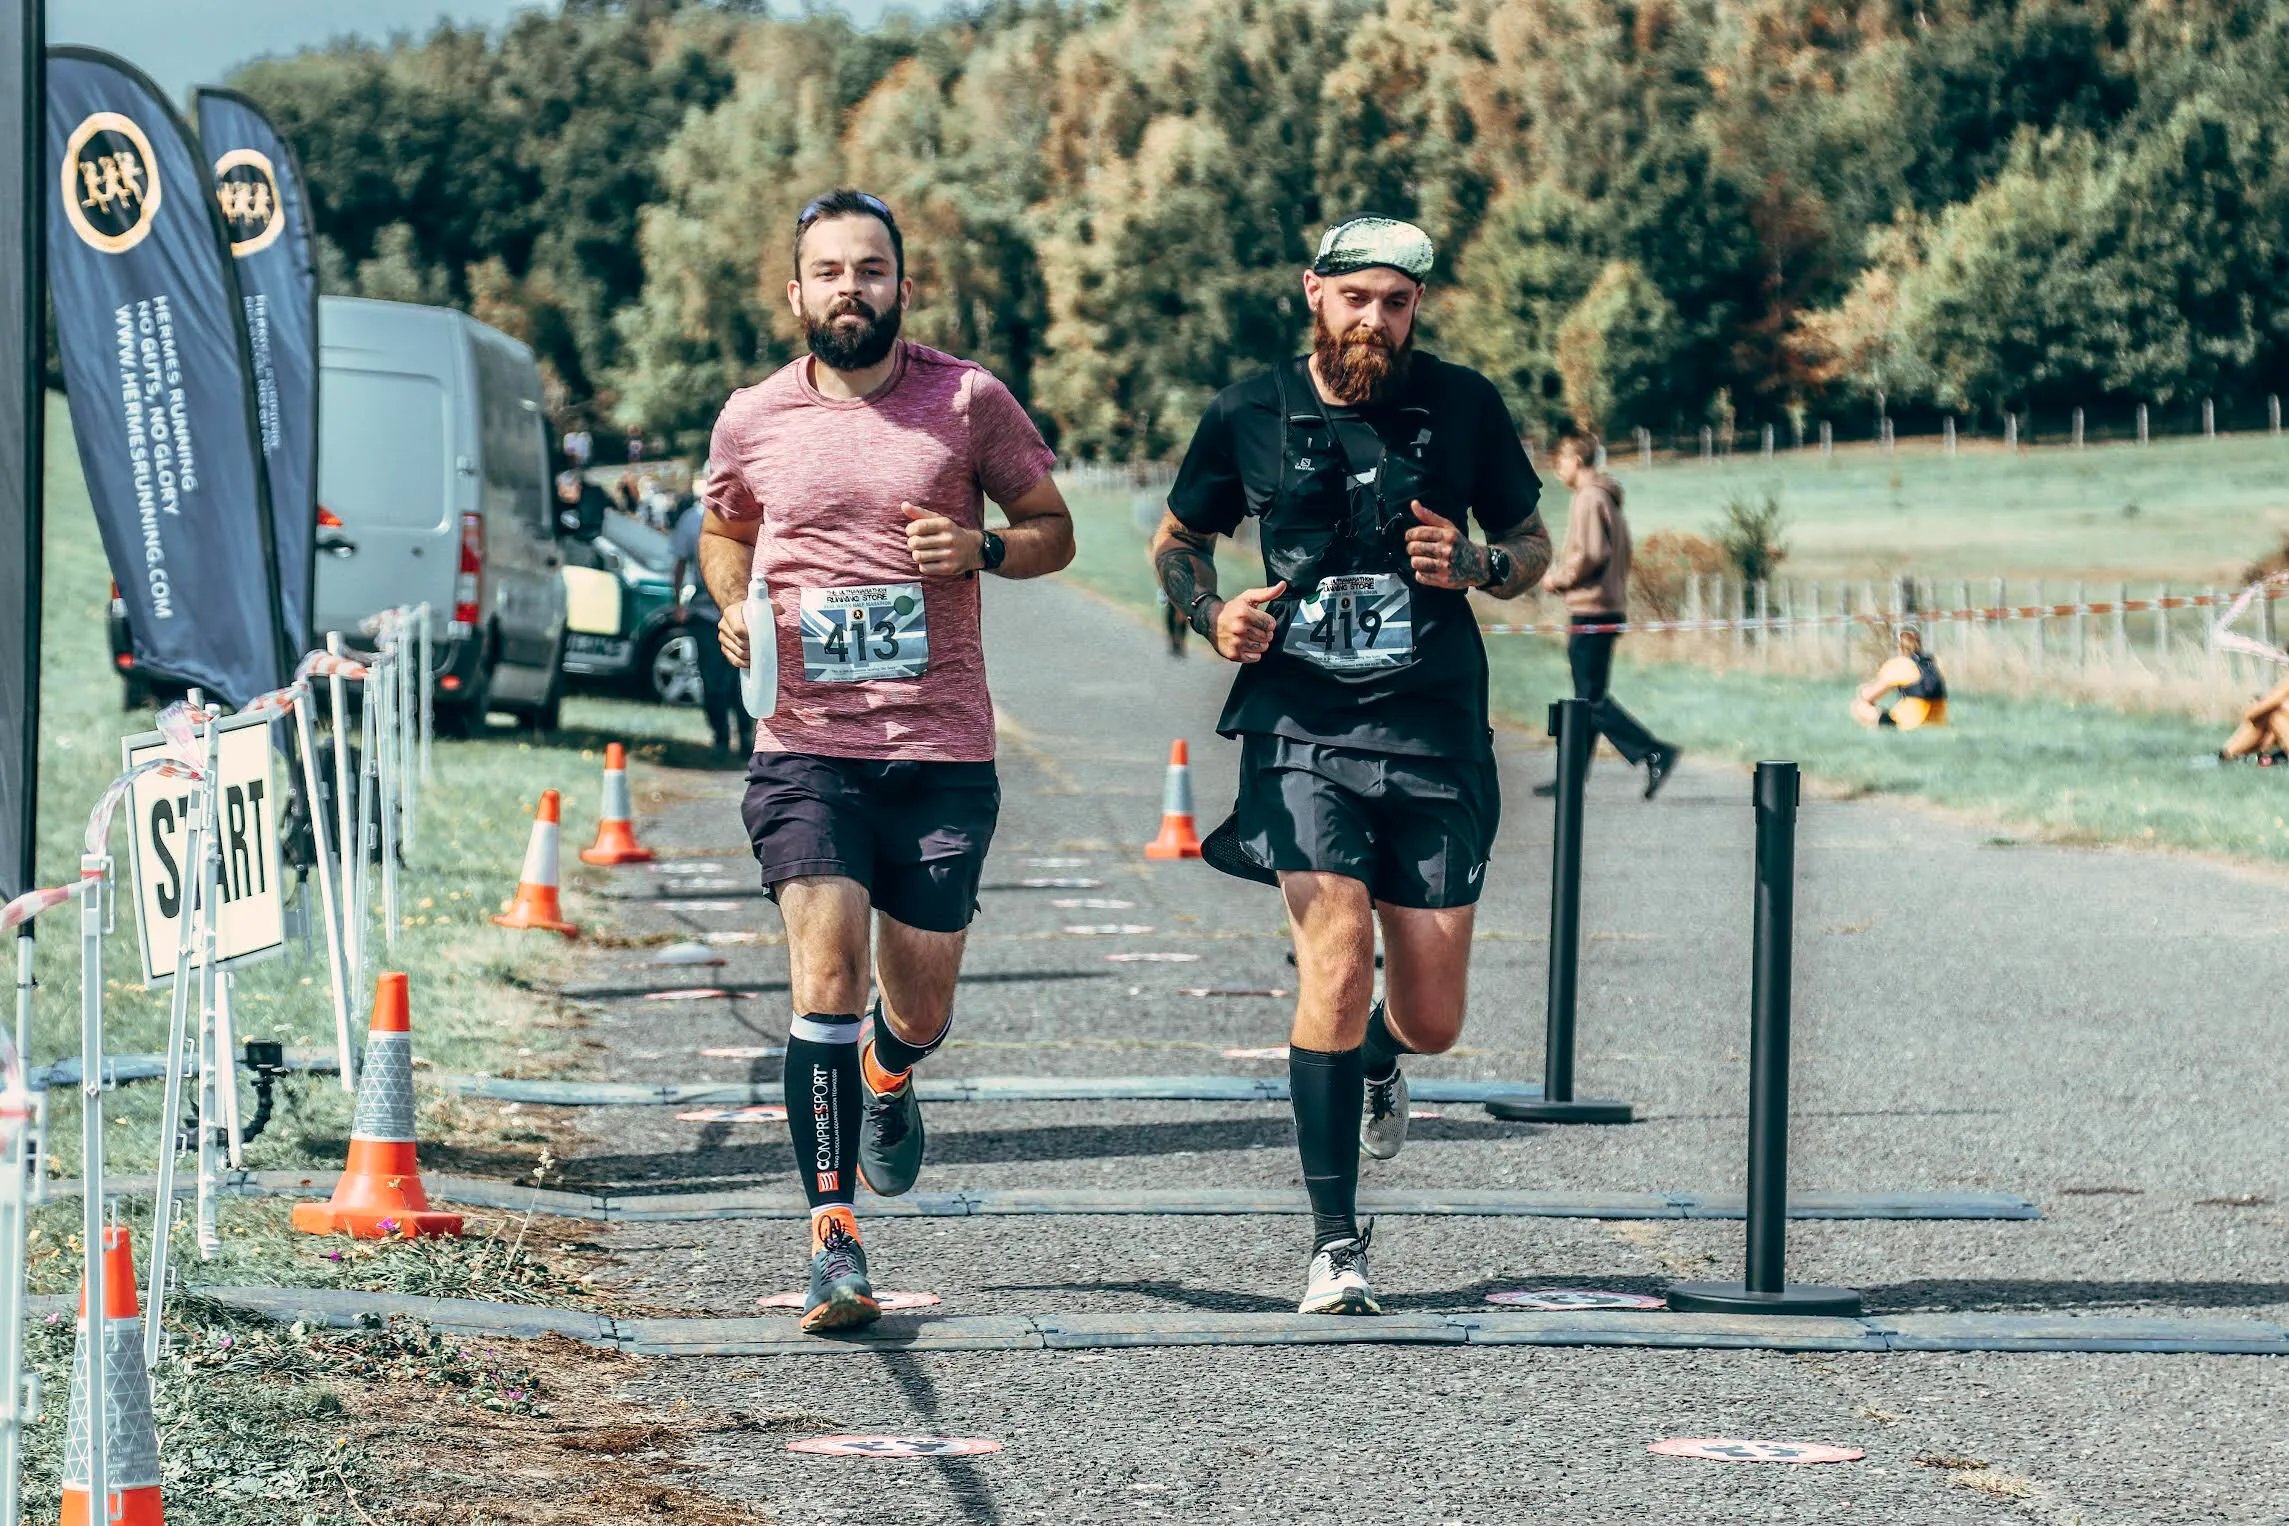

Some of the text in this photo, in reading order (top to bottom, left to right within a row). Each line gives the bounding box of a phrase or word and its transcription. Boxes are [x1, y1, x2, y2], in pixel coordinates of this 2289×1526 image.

[115, 303, 175, 620] WWW.HERMESRUNNING.COM
[137, 300, 181, 516] NO GUTS, NO GLORY
[152, 295, 199, 493] HERMES RUNNING
[823, 621, 899, 662] 413
[826, 596, 860, 604] RUNNING
[1310, 610, 1382, 651] 419
[151, 779, 265, 918] SRT
